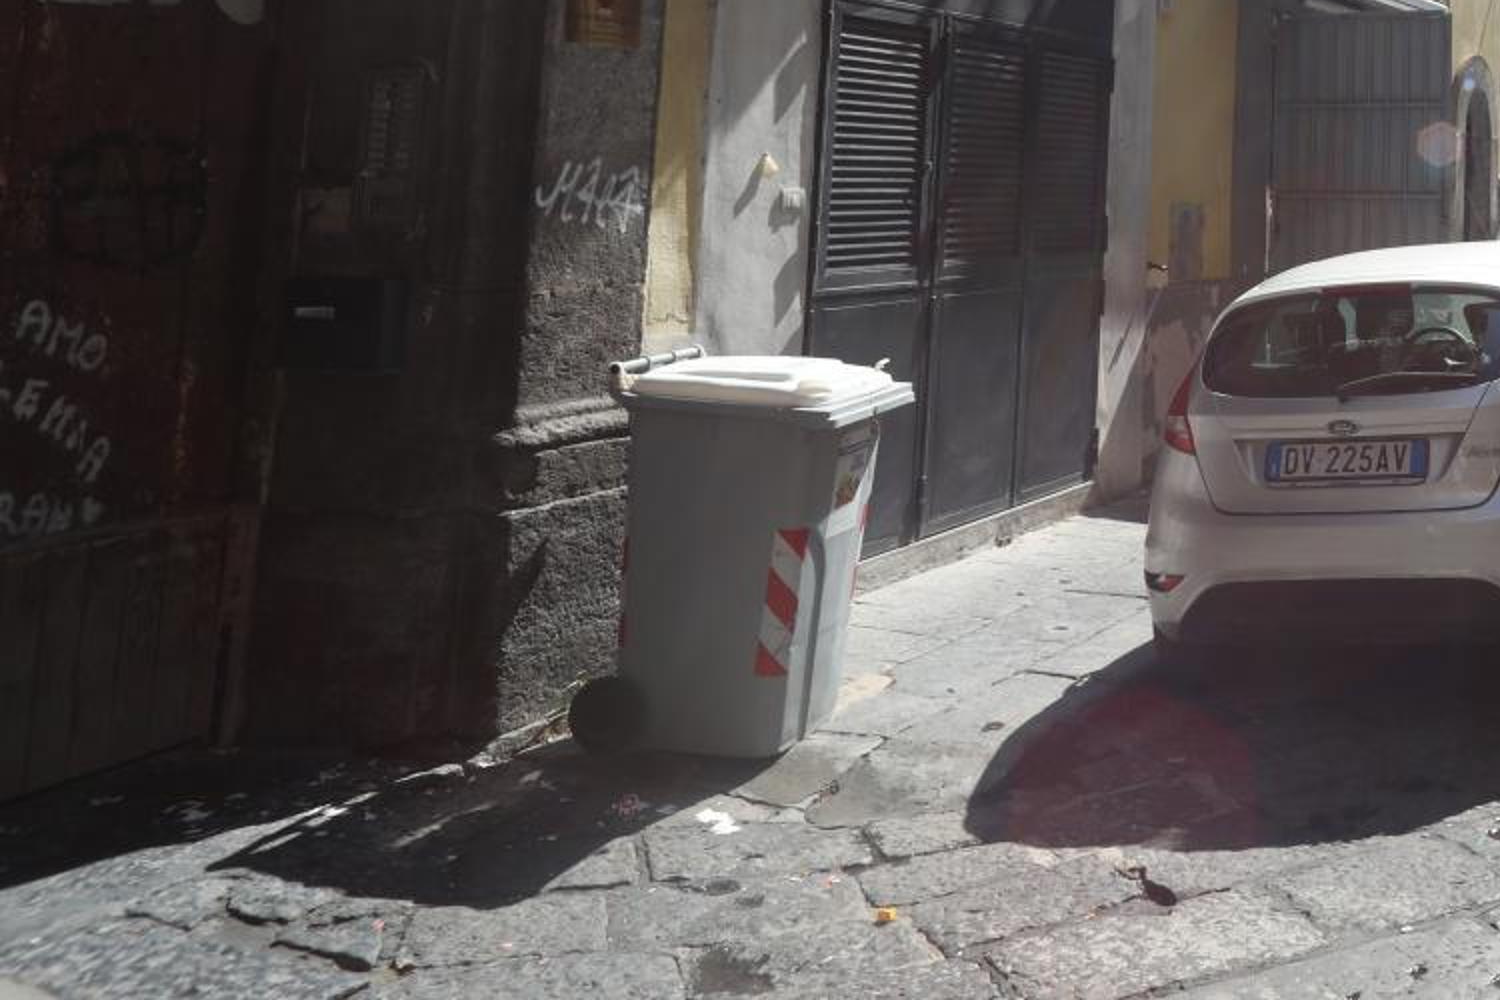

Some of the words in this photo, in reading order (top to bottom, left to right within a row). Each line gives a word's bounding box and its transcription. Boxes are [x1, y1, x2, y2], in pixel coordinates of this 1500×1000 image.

[14, 297, 109, 372] AMO
[1284, 446, 1316, 475] DV
[1325, 442, 1410, 474] 225AV
